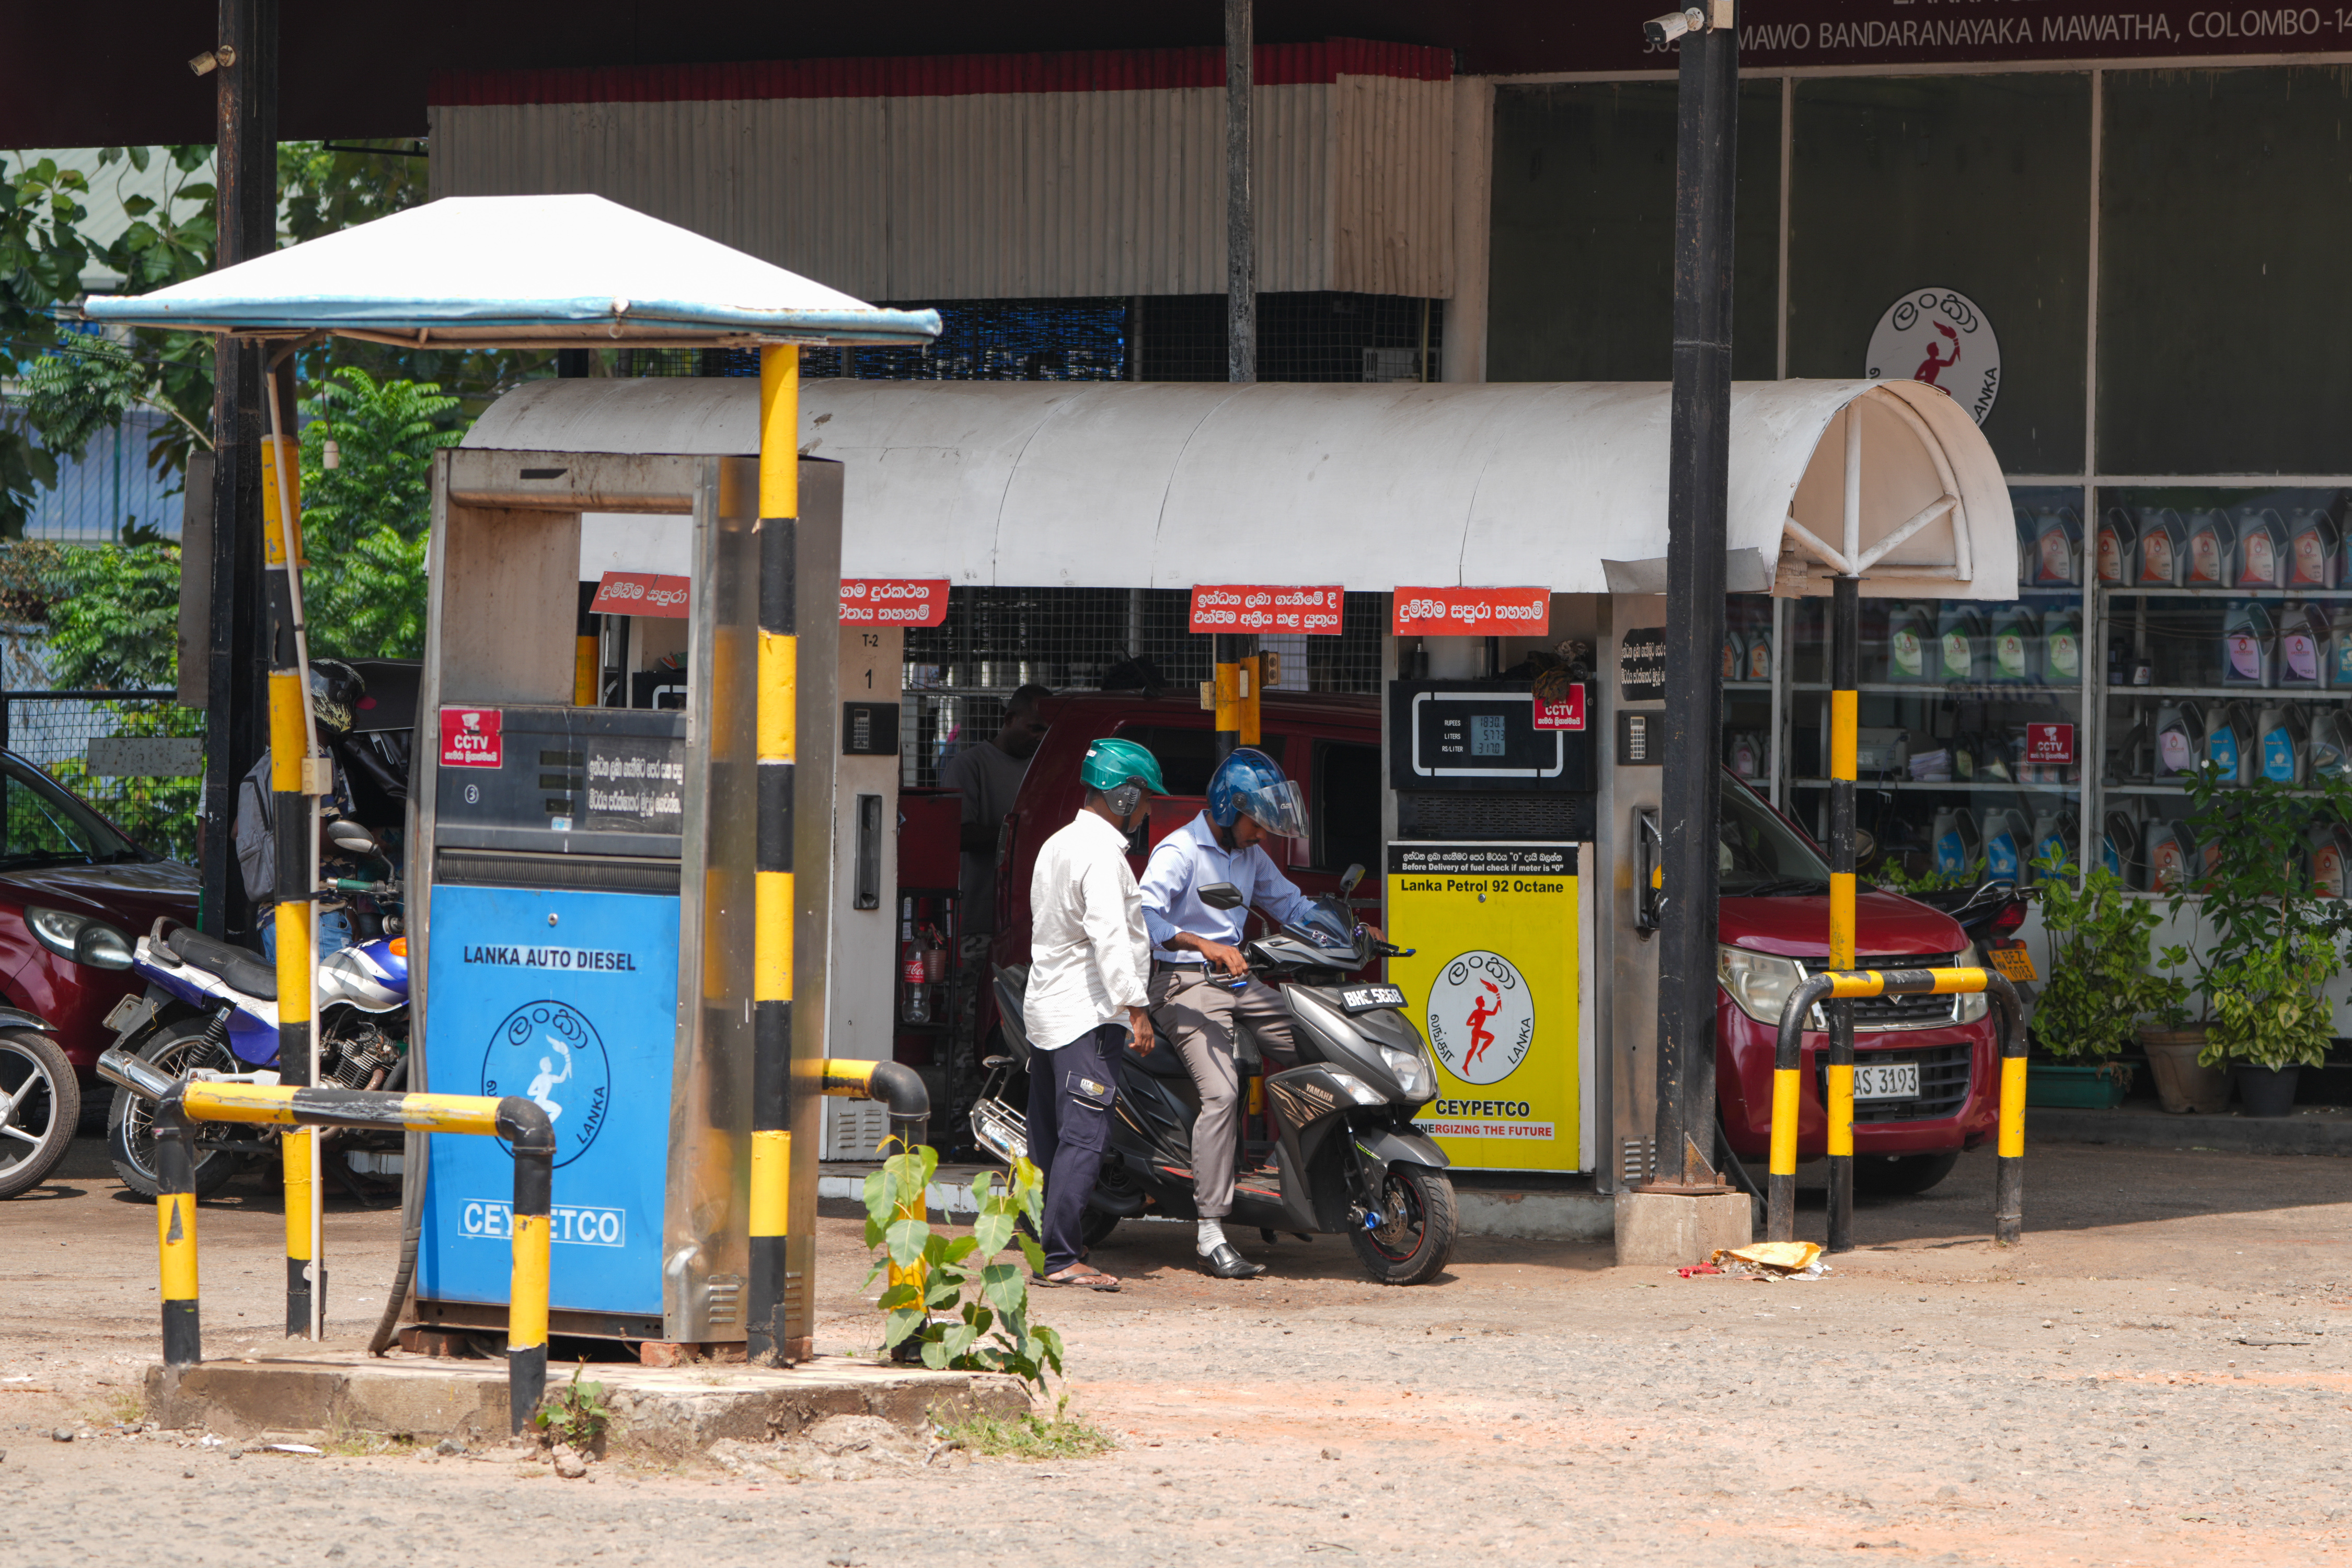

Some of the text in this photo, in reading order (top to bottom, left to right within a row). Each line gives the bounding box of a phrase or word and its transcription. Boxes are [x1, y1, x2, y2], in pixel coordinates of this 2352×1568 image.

[1738, 23, 1811, 50] MAWO
[1819, 17, 2033, 48] BANDARANAYAKA
[2042, 14, 2181, 43] MAWATHA,
[647, 589, 687, 606] සපුරා
[840, 583, 929, 602] ගම දුරකථන
[1197, 591, 1241, 608] ඉන්ධන
[1245, 592, 1271, 608] ලබා
[1275, 591, 1323, 605] ගැනීමේ
[839, 603, 929, 620] විතය තහනම්
[1399, 599, 1543, 624] දුම්බීම සපුරා තහනම්
[1276, 614, 1299, 627] කළ
[1304, 614, 1338, 628] යුතුය
[862, 634, 878, 647] T-2
[865, 668, 872, 689] 1
[1545, 705, 1573, 716] CCTV
[454, 734, 489, 750] CCTV
[2038, 742, 2062, 751] CCTV
[1403, 851, 1425, 862] ඉන්ධන
[1427, 852, 1440, 861] ලබා
[1443, 852, 1468, 861] ගැනීමට
[1539, 852, 1562, 862] බලන්න
[1428, 863, 1459, 872] Delivery
[1401, 879, 1564, 892] Lanka Petrol 92 Octane
[464, 946, 636, 971] LANKA AUTO DIESEL
[2001, 951, 2025, 964] BEZ
[1343, 989, 1373, 1007] BHC
[1507, 1018, 1531, 1065] LANKA
[1853, 1068, 1917, 1095] AS 3193
[1307, 1083, 1334, 1103] YAMAHA
[577, 1086, 605, 1144] LANKA
[1435, 1099, 1530, 1117] CEYPETCO
[1483, 1125, 1505, 1135] THE
[1509, 1126, 1552, 1137] FUTURE
[464, 1203, 619, 1243] CEYETCO
